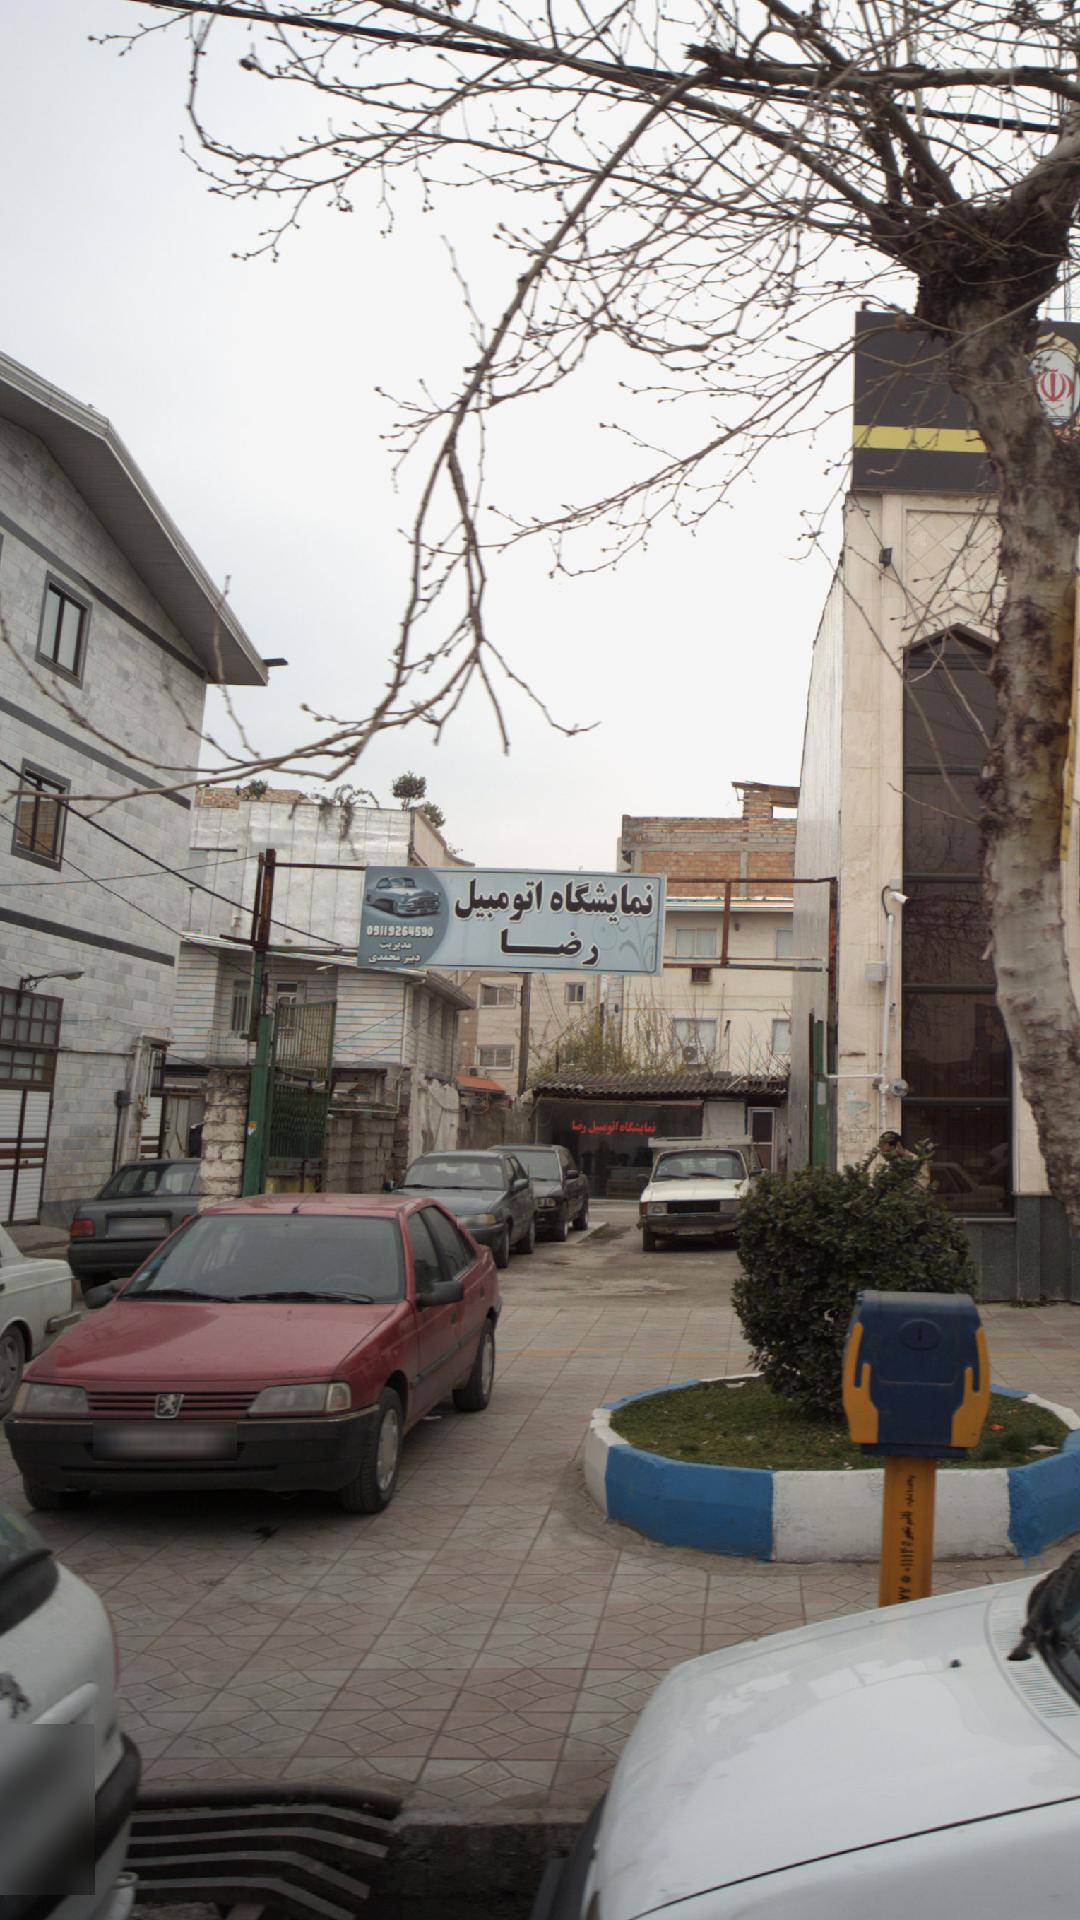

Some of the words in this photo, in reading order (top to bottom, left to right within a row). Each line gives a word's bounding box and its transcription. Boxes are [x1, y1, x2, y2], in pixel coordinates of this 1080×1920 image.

[455, 878, 543, 921] اتومبیل
[550, 880, 653, 923] نمایشگاه
[366, 925, 434, 937] 09119264590
[379, 942, 412, 951] مدیریت
[500, 928, 599, 965] رضا
[368, 954, 400, 963] محمدی
[571, 1119, 586, 1134] رضا
[587, 1119, 619, 1135] اتومبیل
[619, 1119, 656, 1135] نمایشگاه
